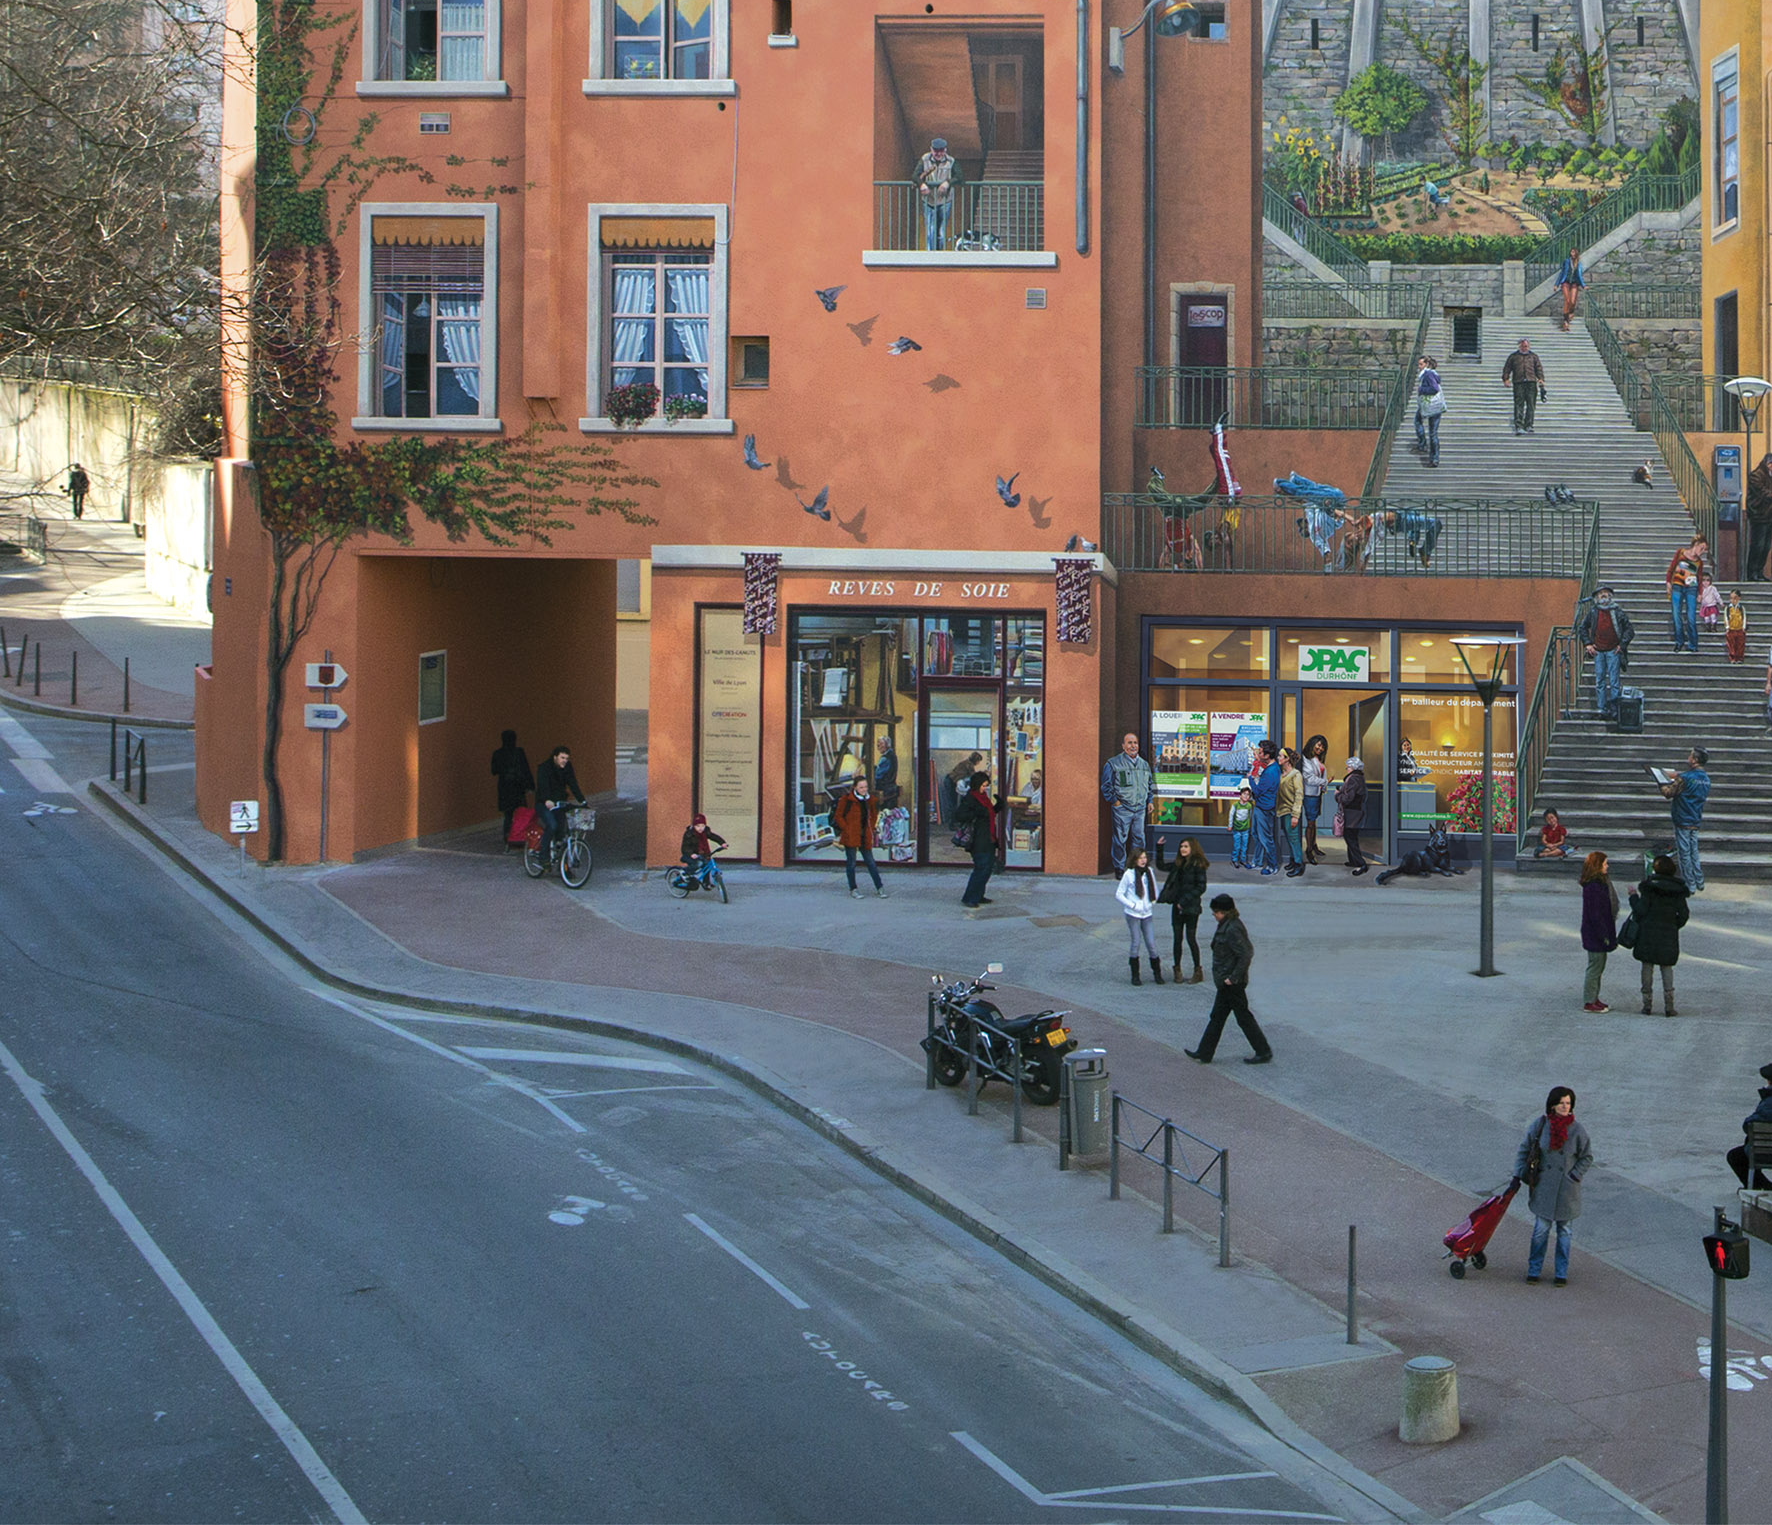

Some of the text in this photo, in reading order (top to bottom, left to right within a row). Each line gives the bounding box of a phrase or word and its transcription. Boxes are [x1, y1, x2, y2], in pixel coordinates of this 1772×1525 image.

[828, 580, 1010, 598] REVES DE SOIE
[1300, 648, 1367, 672] OPAC
[1316, 671, 1358, 681] DURHÔNE
[1412, 697, 1444, 706] bailleur
[1446, 698, 1458, 707] du
